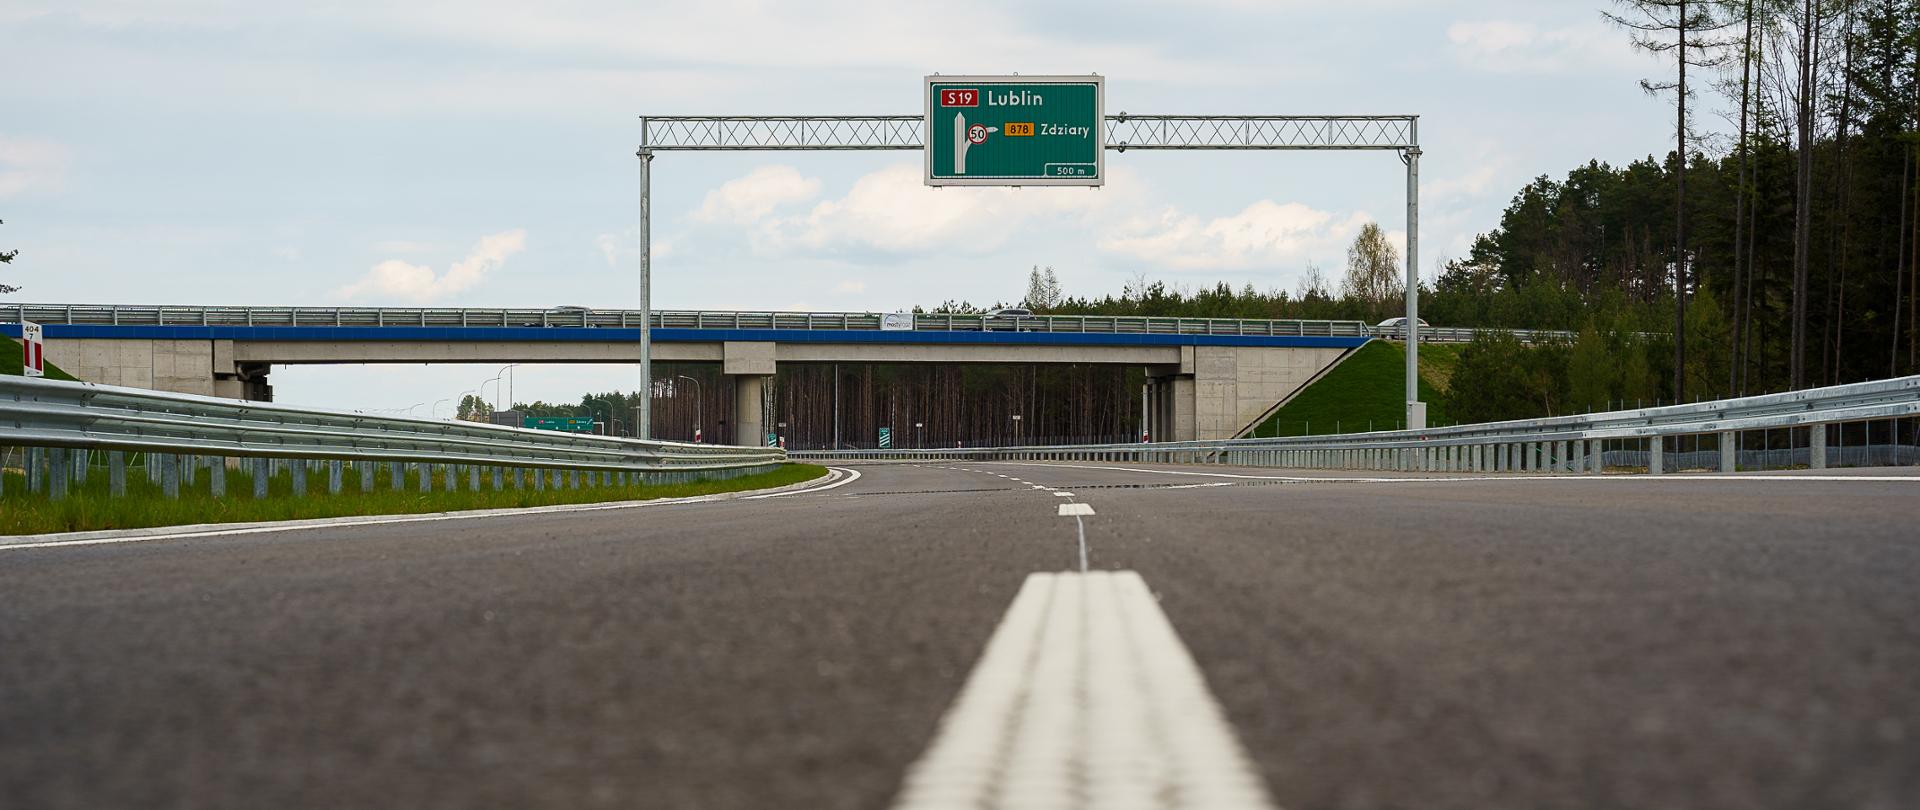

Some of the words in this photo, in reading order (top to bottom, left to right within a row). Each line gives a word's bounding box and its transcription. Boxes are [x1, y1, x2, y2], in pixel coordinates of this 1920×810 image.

[988, 91, 1043, 105] Lublin
[970, 130, 985, 139] 50
[1010, 125, 1029, 134] 878
[1041, 124, 1090, 138] Zdziary
[1057, 167, 1074, 175] 500
